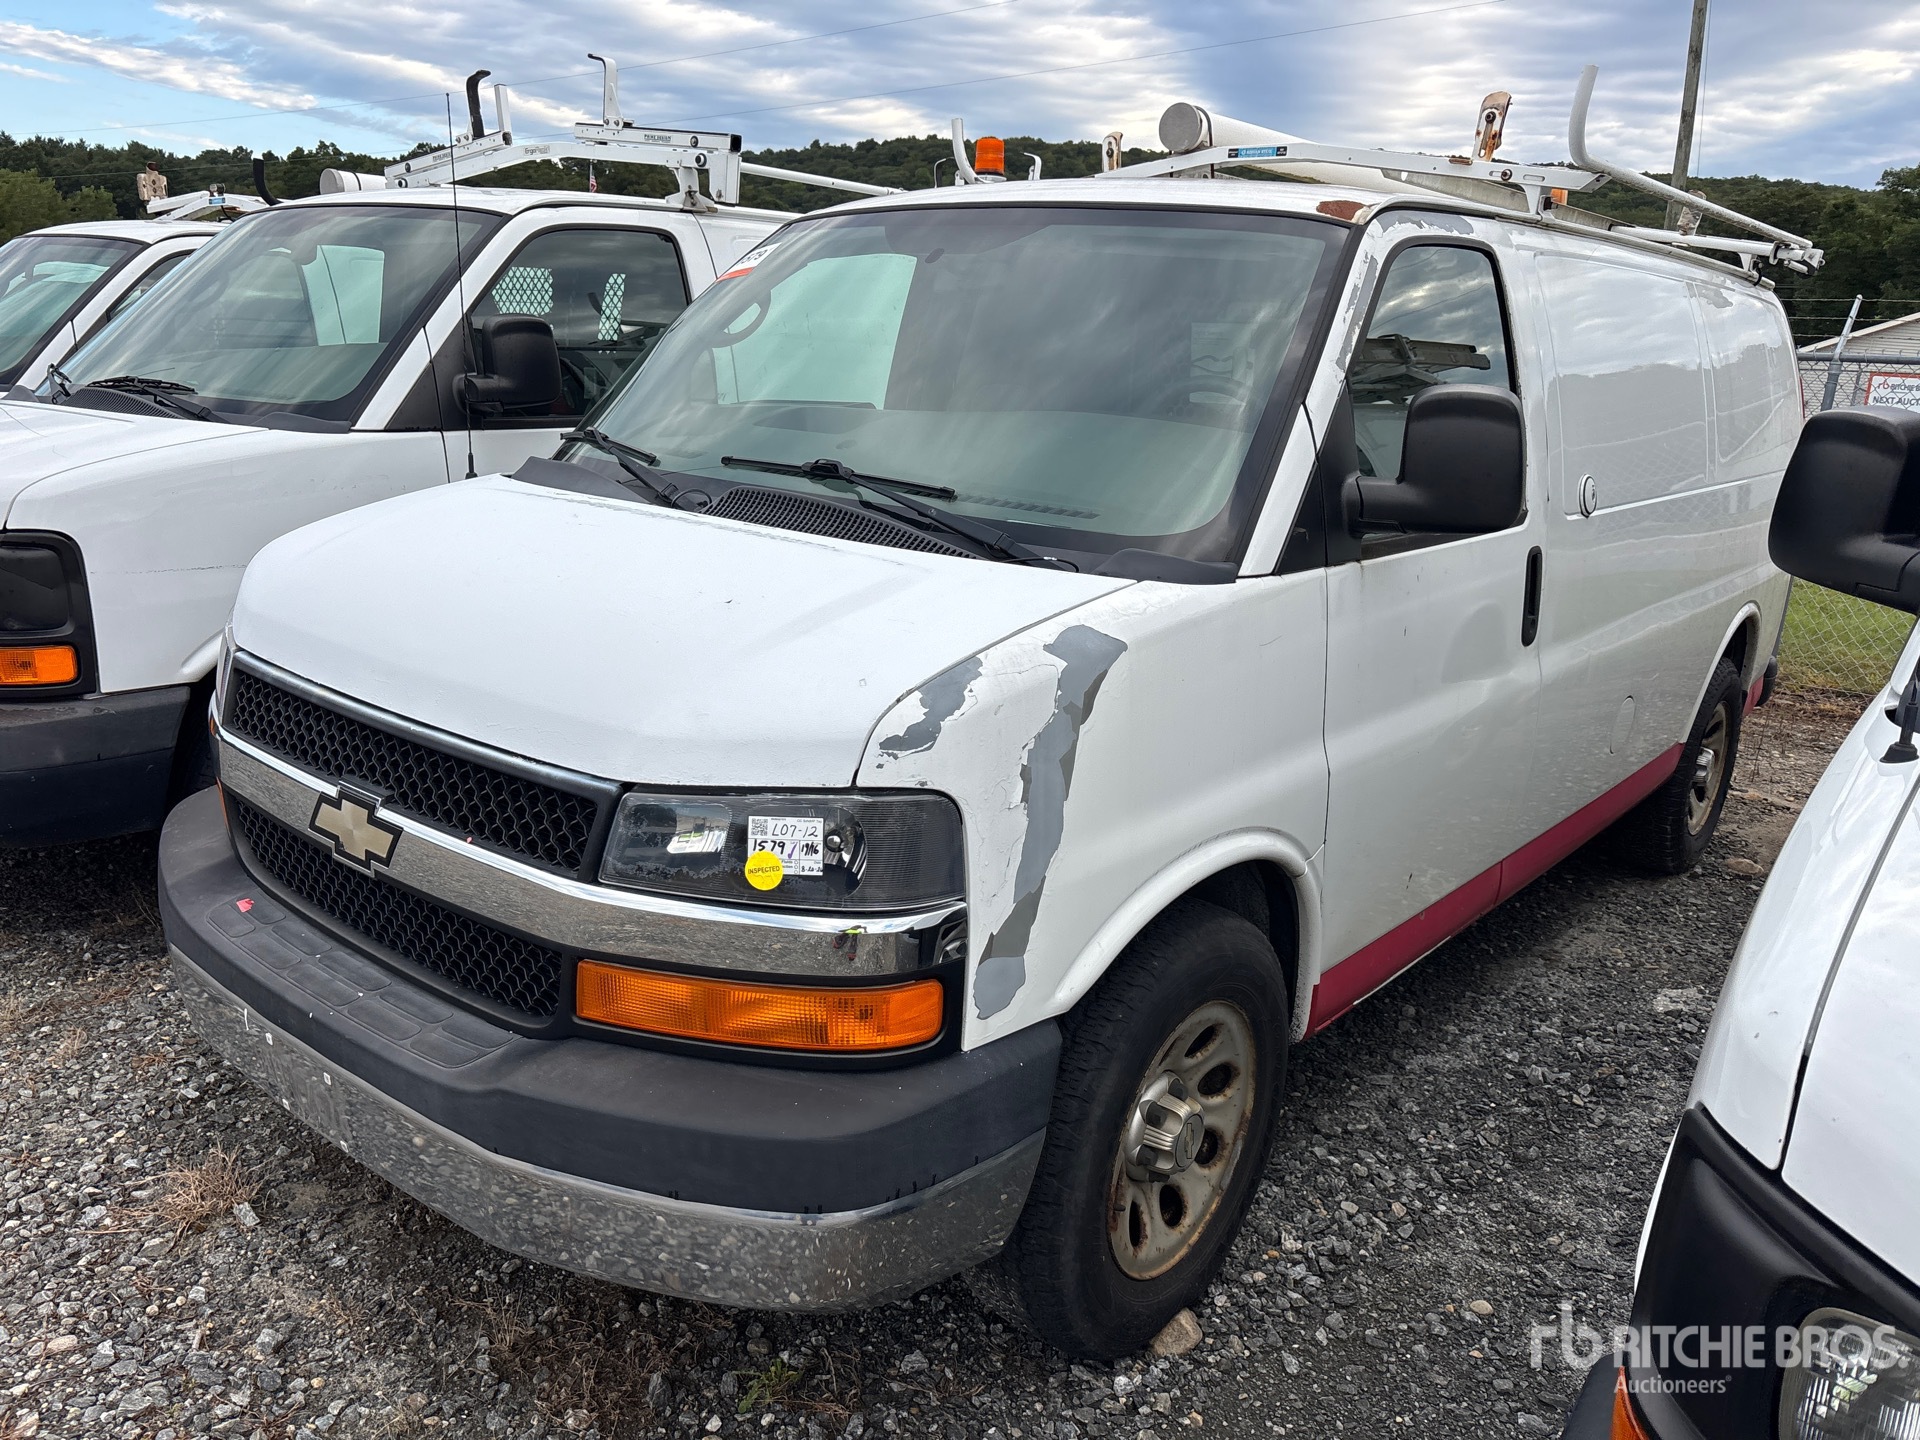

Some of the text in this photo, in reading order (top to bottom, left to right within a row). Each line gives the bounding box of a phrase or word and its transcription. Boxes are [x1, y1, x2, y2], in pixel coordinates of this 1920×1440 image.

[1873, 396, 1896, 404] NEXT
[752, 839, 786, 855] 1579
[748, 866, 780, 874] INSPECTED
